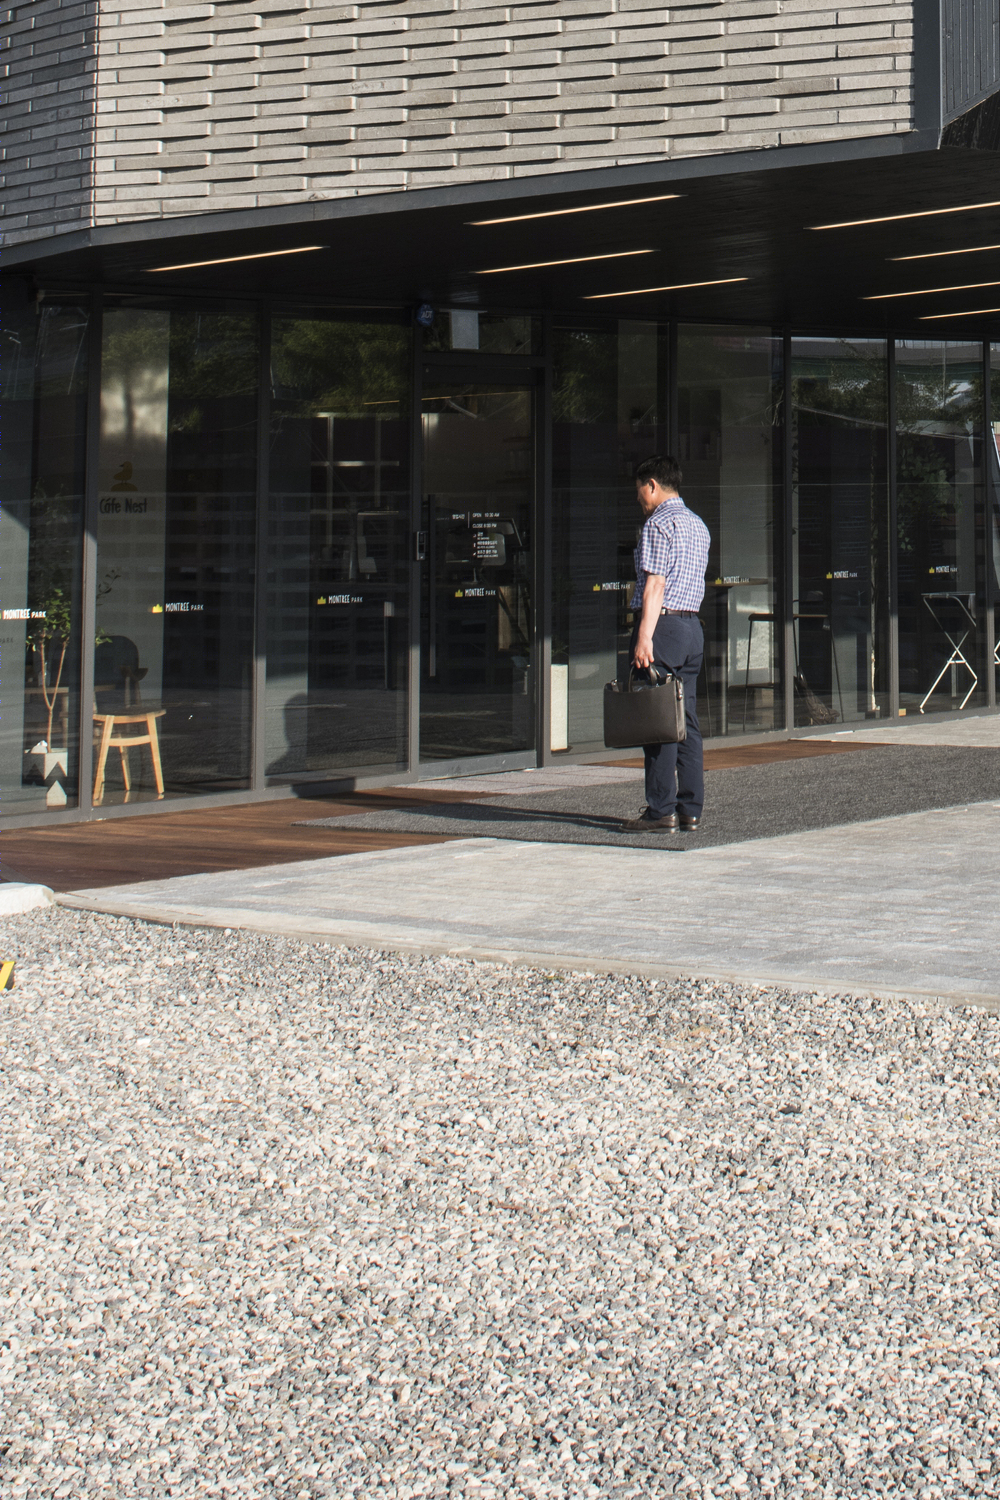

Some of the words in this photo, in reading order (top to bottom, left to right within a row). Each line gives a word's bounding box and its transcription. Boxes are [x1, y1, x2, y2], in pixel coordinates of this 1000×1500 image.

[125, 498, 148, 513] Nest
[935, 565, 950, 573] MONTREE
[833, 570, 849, 578] MONTREE
[723, 575, 740, 584] MONTREE
[602, 582, 620, 590] MONTREE
[464, 588, 485, 597] MONTREE
[328, 595, 350, 604] MONTREE
[165, 602, 190, 612] MONTREE
[3, 609, 31, 619] MONTREE
